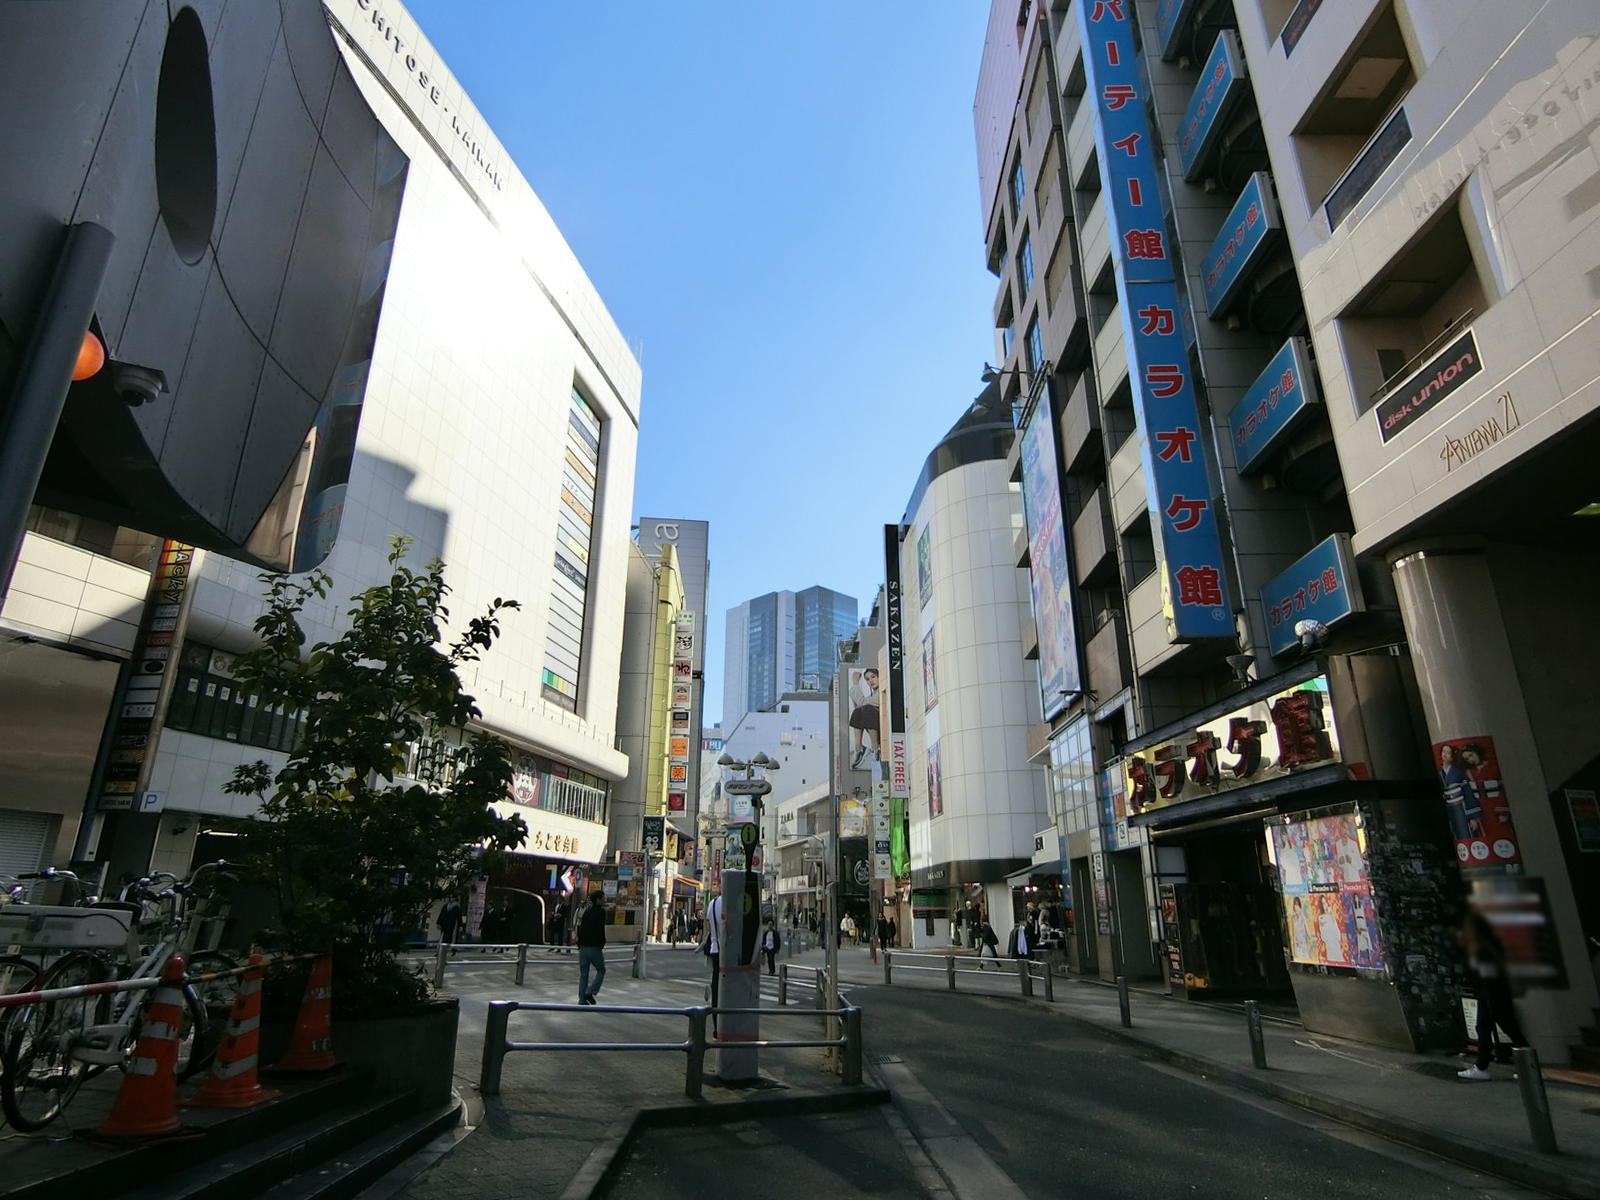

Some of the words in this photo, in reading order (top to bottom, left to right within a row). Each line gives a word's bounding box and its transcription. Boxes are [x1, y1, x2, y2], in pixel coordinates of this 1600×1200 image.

[1237, 367, 1296, 445] カラオケ館
[1384, 404, 1413, 430] disk
[1411, 352, 1474, 407] union
[1138, 304, 1223, 607] カラオケ館
[889, 580, 901, 671] SAKAZEN
[1270, 566, 1339, 628] カラオケ館
[893, 740, 904, 758] TAX
[894, 760, 905, 784] FREE
[780, 811, 794, 825] ZARA
